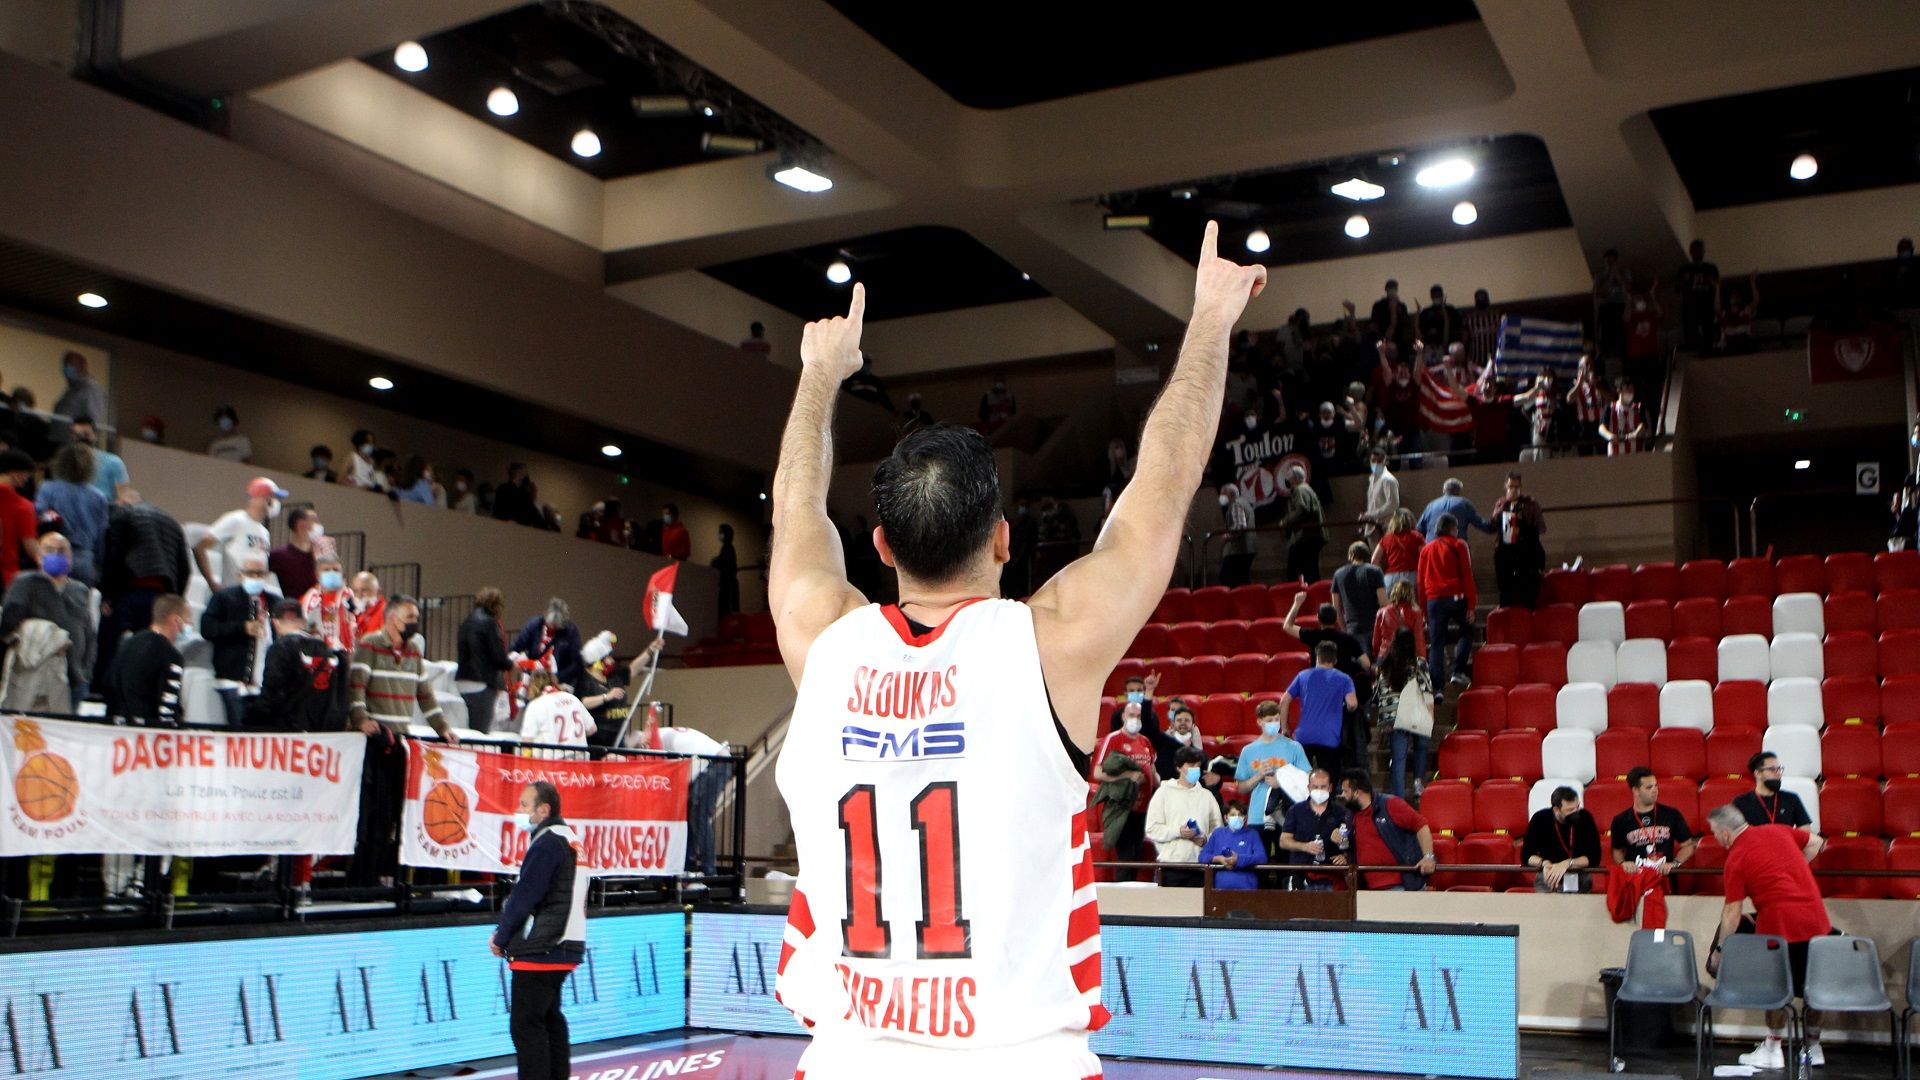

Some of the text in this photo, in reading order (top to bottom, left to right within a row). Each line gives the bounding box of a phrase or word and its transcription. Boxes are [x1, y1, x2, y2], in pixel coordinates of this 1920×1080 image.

[1226, 430, 1294, 465] Toulon
[1858, 467, 1878, 489] G
[847, 665, 957, 720] SLOUKAS
[554, 710, 584, 742] 25
[842, 722, 965, 758] FMS
[112, 733, 341, 783] DAGHE MUNEGU
[603, 773, 672, 791] FOREVER
[584, 825, 670, 869] MUNEGU
[838, 781, 972, 960] 11
[568, 1050, 725, 1080] IRLINES
